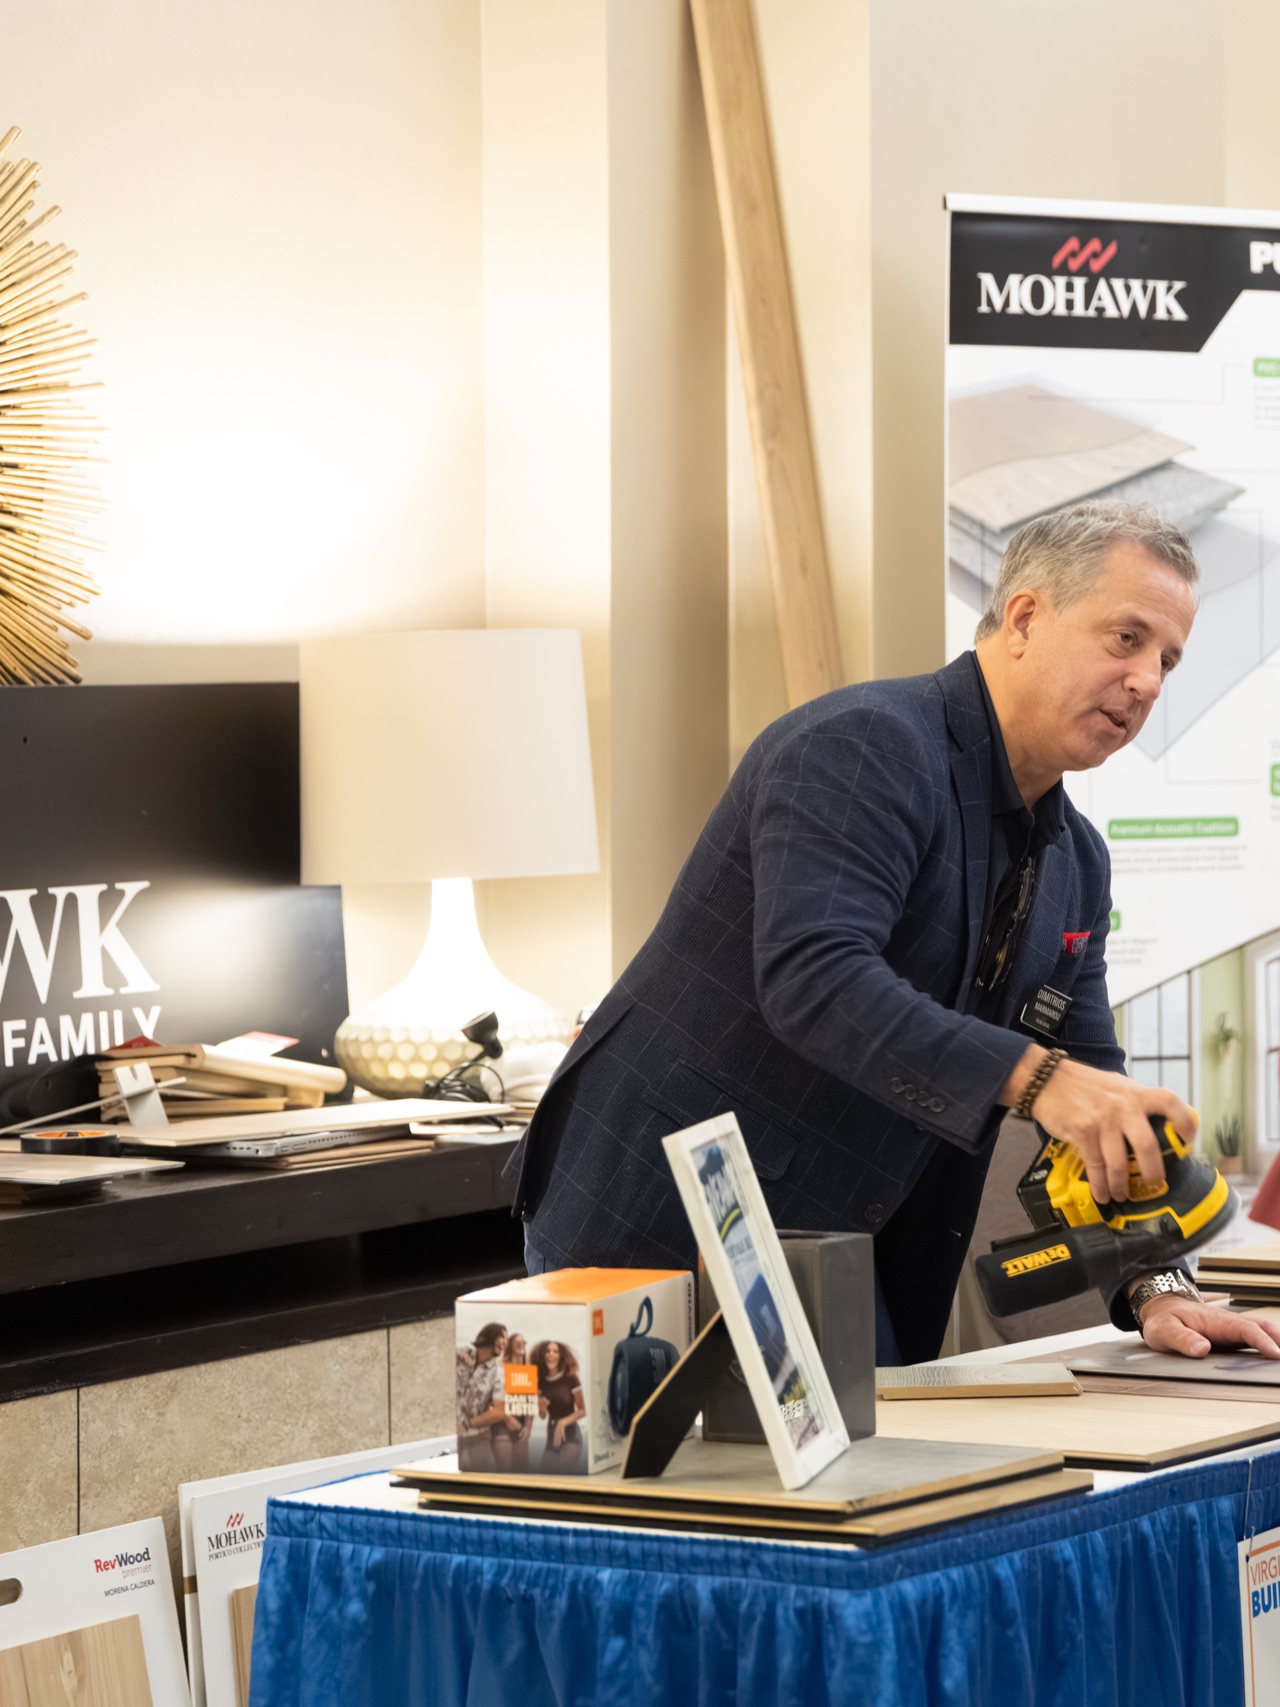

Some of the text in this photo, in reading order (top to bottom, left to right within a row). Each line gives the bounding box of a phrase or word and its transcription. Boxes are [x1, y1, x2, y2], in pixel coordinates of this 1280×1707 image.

[977, 271, 1189, 321] MOHAWK
[207, 1522, 266, 1552] MOHAWK
[93, 1547, 152, 1573] RevWood
[121, 1563, 153, 1580] premier
[104, 1578, 156, 1597] MORENA CALDERA
